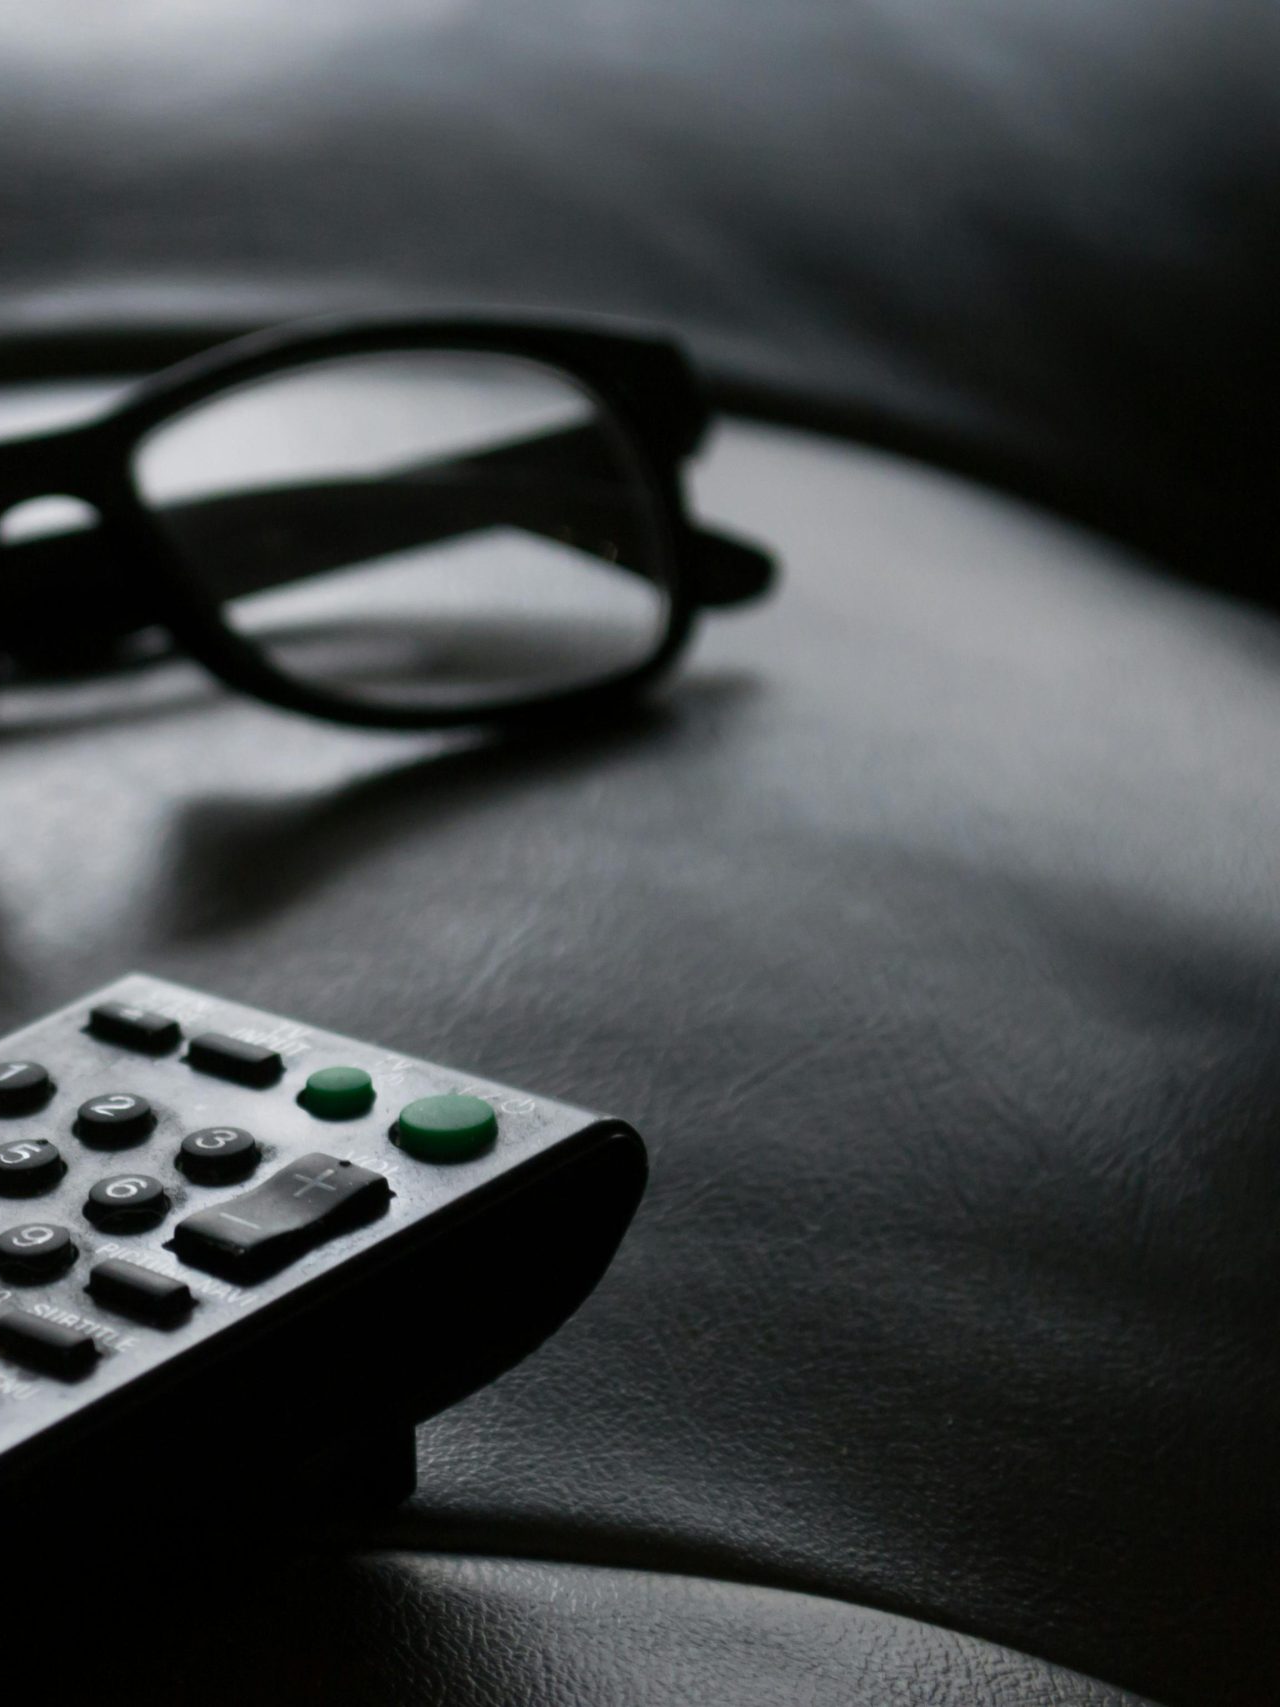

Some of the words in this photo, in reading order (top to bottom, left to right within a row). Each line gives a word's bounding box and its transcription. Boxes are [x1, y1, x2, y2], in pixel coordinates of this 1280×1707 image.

[91, 1096, 136, 1116] 2
[195, 1130, 238, 1150] 3
[106, 1177, 148, 1198] 6
[12, 1226, 54, 1247] 9
[30, 1302, 140, 1352] SUBTITLE
